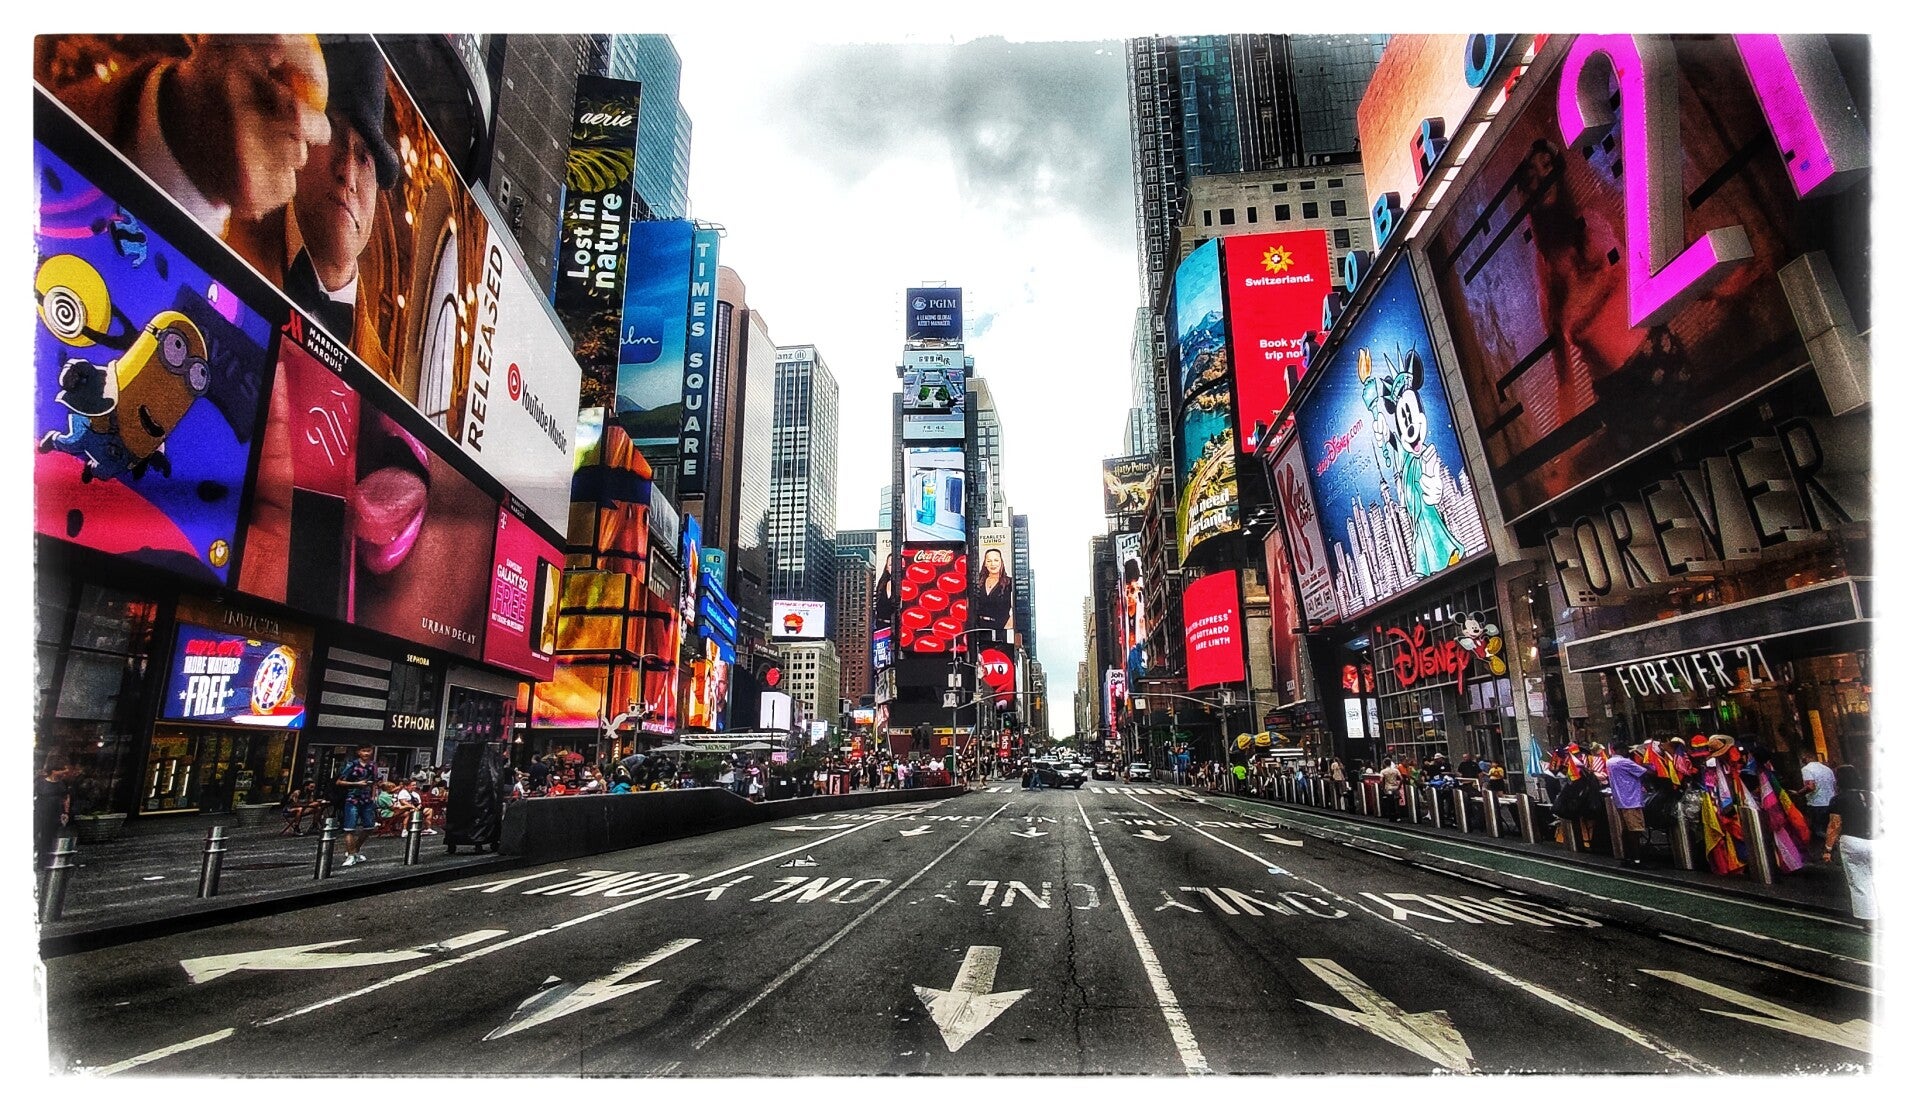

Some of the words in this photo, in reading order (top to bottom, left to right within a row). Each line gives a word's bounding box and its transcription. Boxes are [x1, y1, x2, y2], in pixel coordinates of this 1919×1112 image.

[580, 111, 633, 127] aerie
[570, 199, 596, 220] in
[567, 227, 594, 278] Lost
[595, 193, 622, 289] nature
[691, 243, 710, 337] TIMES
[1245, 275, 1314, 287] Switzerland.
[930, 299, 956, 309] PGIM
[307, 340, 343, 372] MARQUIS
[309, 327, 349, 364] MARRIOTT
[468, 245, 503, 452] RELEASED
[1260, 338, 1290, 348] Book
[1265, 351, 1284, 361] trip
[521, 380, 549, 432] YouTube
[549, 413, 567, 455] Music
[684, 352, 705, 476] SQUARE
[1114, 466, 1132, 476] Harry
[1131, 462, 1151, 473] Potter
[1200, 488, 1231, 513] need
[1543, 416, 1853, 608] FOREVER
[497, 564, 519, 587] GALAXY
[518, 578, 528, 592] S22
[493, 578, 527, 624] FREE
[224, 610, 279, 635] INVICTA
[421, 617, 451, 635] URBAN
[452, 628, 476, 644] DECAY
[184, 656, 207, 674] MORE
[207, 657, 241, 674] WATCHES
[406, 654, 429, 666] SEPHORA
[1615, 648, 1734, 700] FOREVER
[1737, 644, 1775, 685] 21
[183, 675, 231, 717] FREE
[392, 714, 435, 731] SEPHORA
